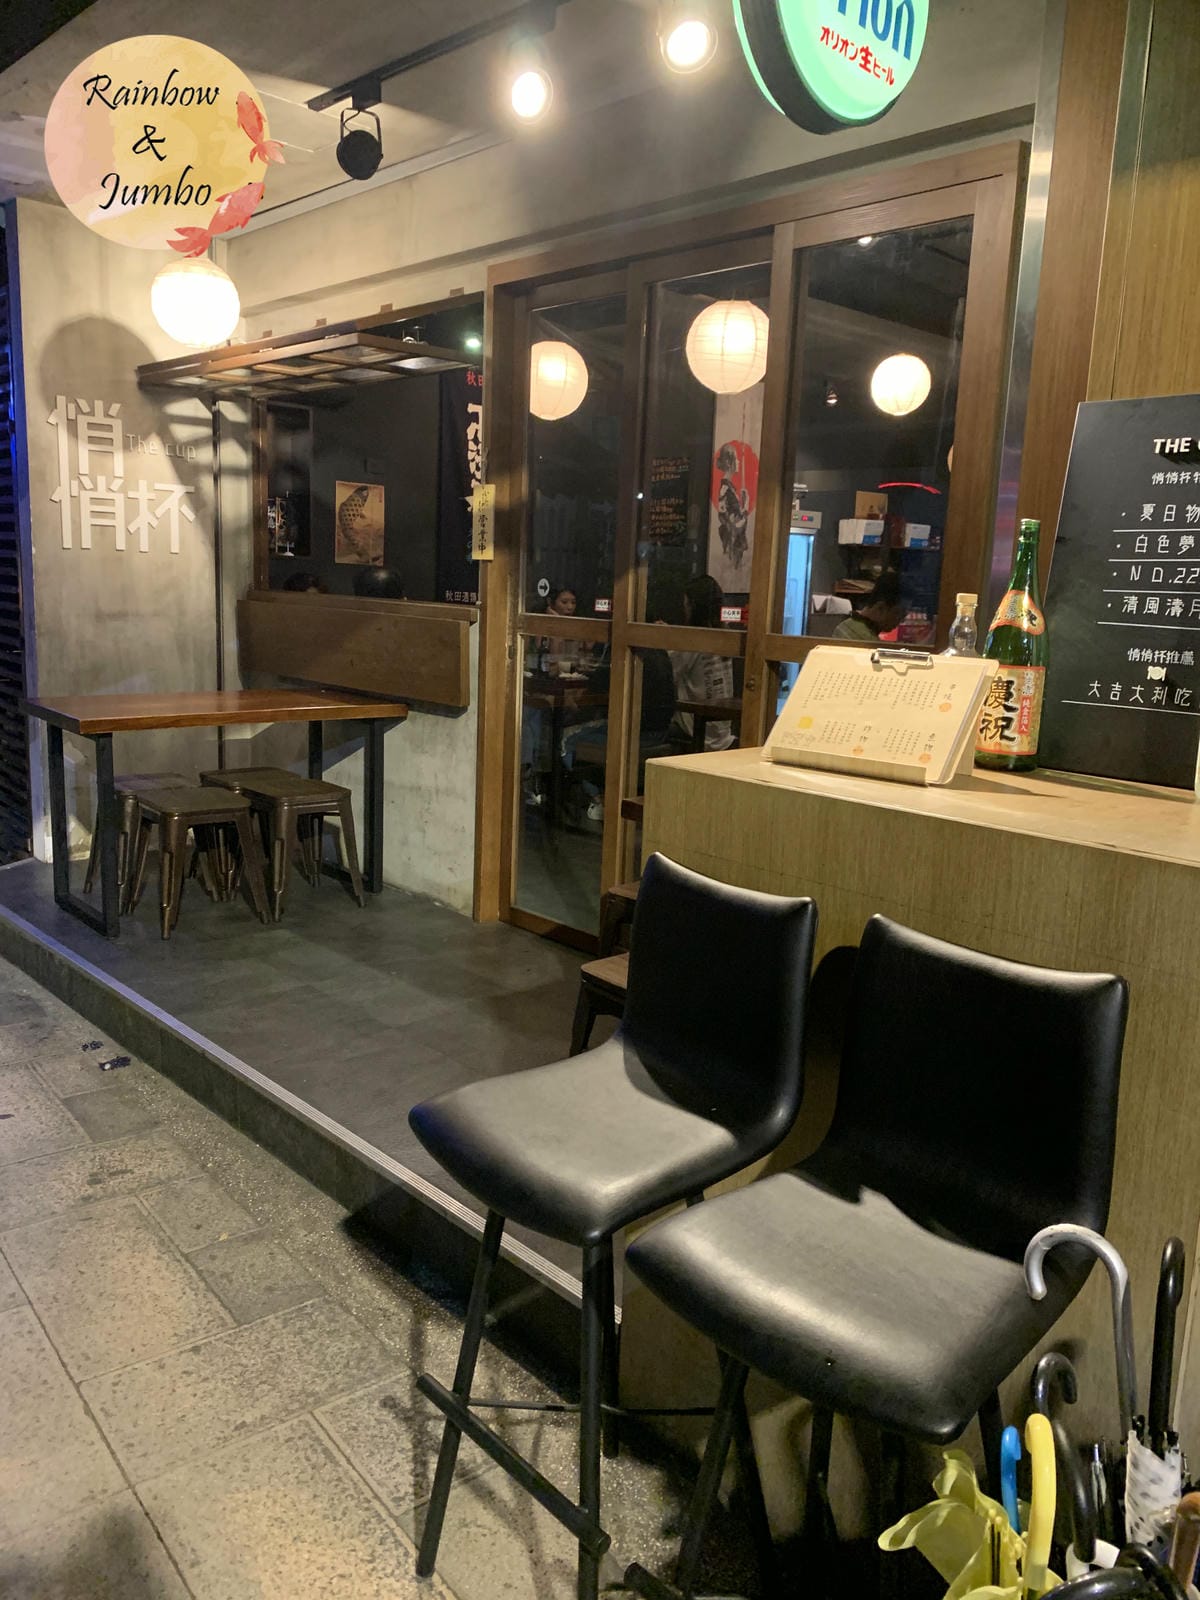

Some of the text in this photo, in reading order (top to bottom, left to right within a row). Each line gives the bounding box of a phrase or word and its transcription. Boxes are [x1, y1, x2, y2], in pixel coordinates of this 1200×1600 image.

[126, 433, 197, 463] The cup
[1153, 437, 1192, 454] THE
[1088, 680, 1193, 707] 大吉大利吃
